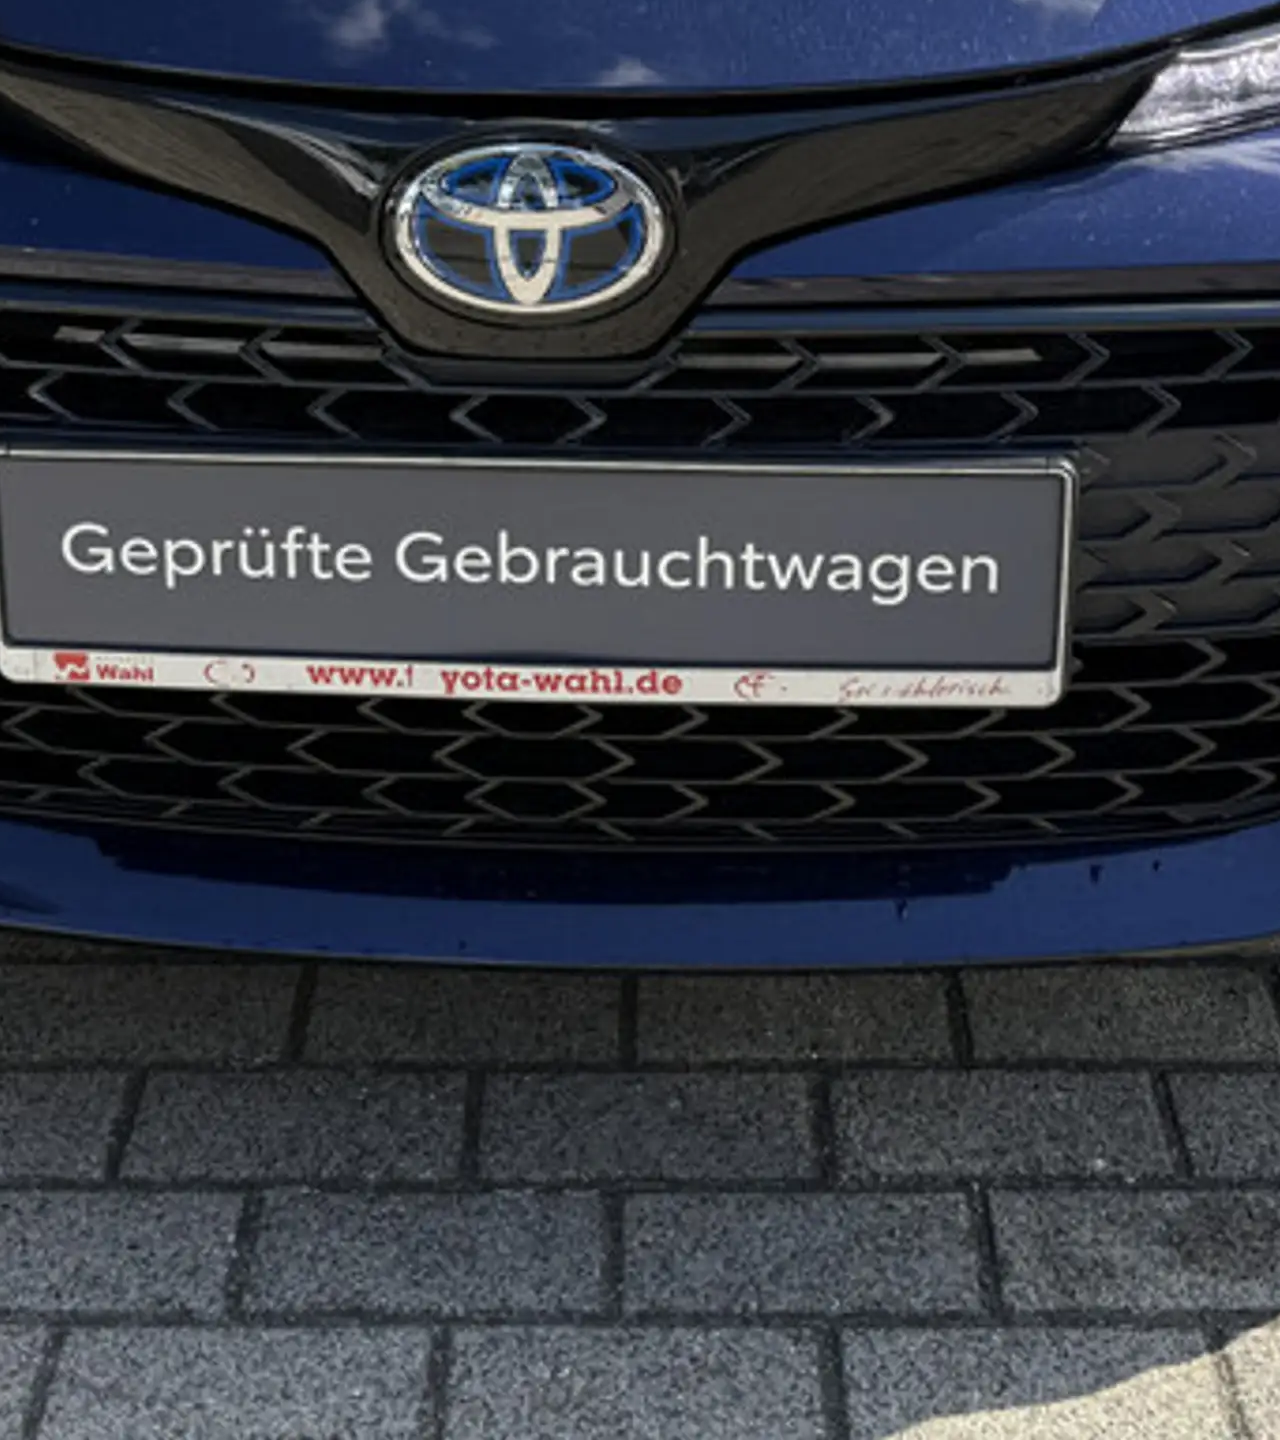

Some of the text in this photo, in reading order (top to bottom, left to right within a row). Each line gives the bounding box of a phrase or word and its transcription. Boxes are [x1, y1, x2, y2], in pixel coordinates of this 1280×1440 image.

[61, 521, 999, 606] Geprüfte Gebrauchtwagen
[96, 664, 154, 682] Wahl
